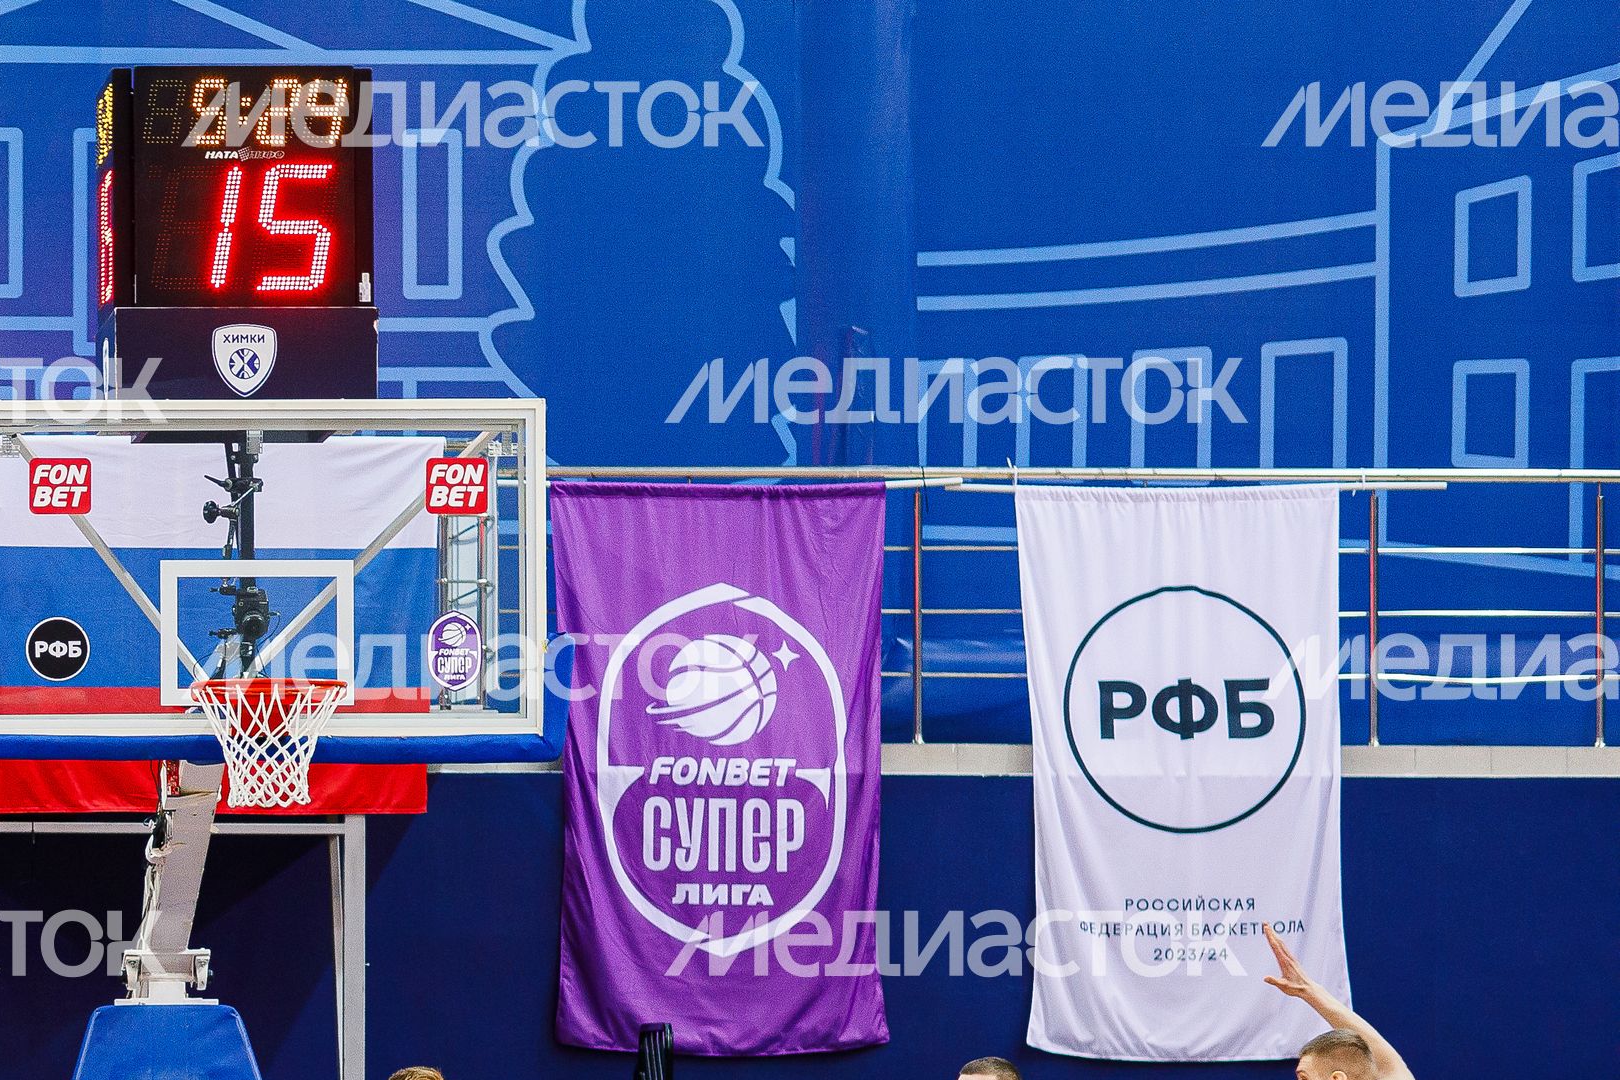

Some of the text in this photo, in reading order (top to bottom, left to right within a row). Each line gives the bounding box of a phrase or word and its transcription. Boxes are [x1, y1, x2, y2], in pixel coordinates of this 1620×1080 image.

[205, 150, 239, 159] НАТА
[211, 164, 333, 291] 15
[223, 334, 265, 344] ХИМКИ
[33, 464, 88, 485] FON
[430, 464, 485, 485] FON
[33, 486, 88, 508] BET
[430, 486, 485, 508] BET
[35, 641, 82, 658] РФБ
[1098, 677, 1275, 741] РФБ
[649, 756, 797, 787] FONBET
[643, 796, 805, 873] СУПЕР
[672, 883, 774, 906] ЛИГА
[1125, 895, 1255, 911] РОССИЙСКАЯ
[1080, 919, 1305, 938] ФЕДЕРАЦИЯ БАСКЕТОЛА
[1153, 948, 1229, 961] 2023/24
